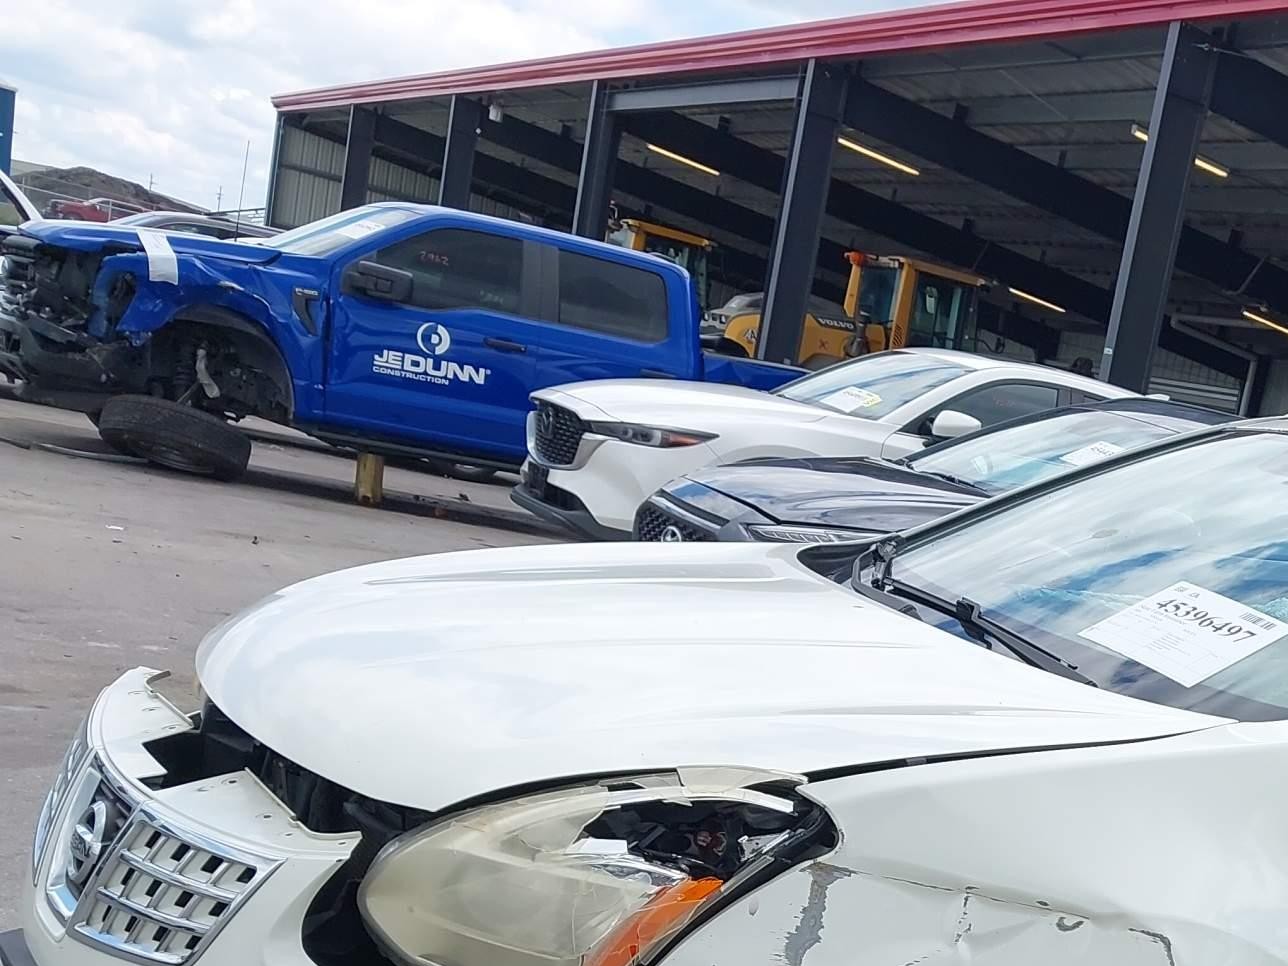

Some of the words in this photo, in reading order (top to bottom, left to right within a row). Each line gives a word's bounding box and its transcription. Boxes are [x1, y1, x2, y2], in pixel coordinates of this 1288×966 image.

[818, 318, 854, 329] VOLVO
[372, 366, 449, 385] CONSTRUCTION
[1156, 599, 1257, 643] 45396497
